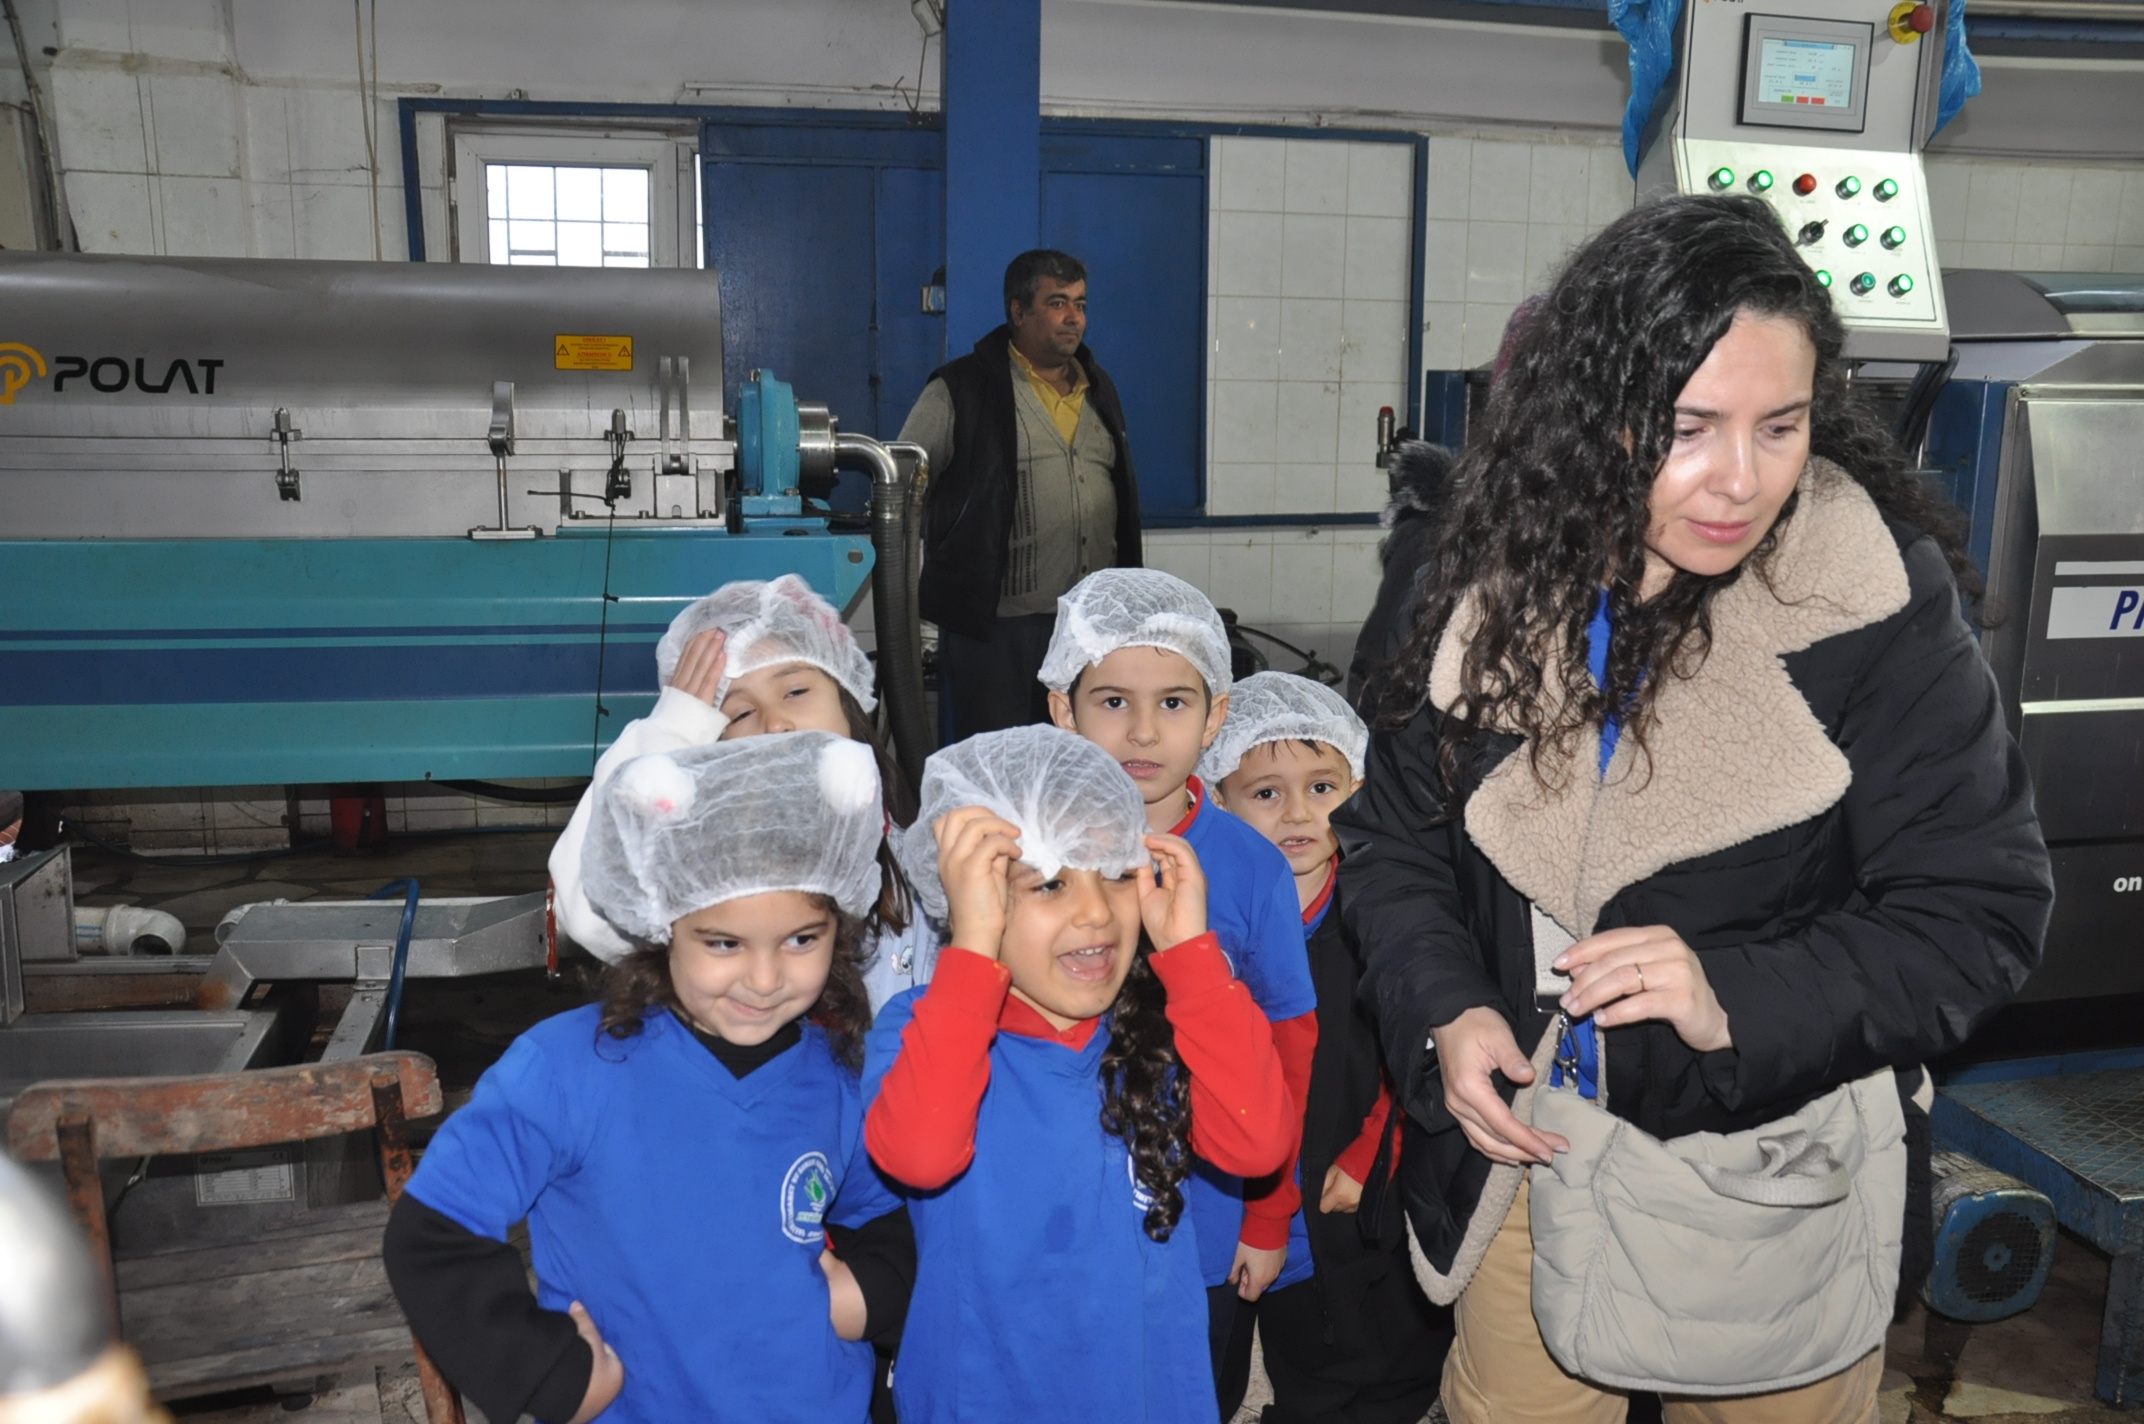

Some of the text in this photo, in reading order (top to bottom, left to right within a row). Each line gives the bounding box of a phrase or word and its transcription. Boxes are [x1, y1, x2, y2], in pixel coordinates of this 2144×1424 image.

[54, 356, 224, 394] POLAT
[2109, 590, 2144, 630] P
[2113, 876, 2143, 893] on
